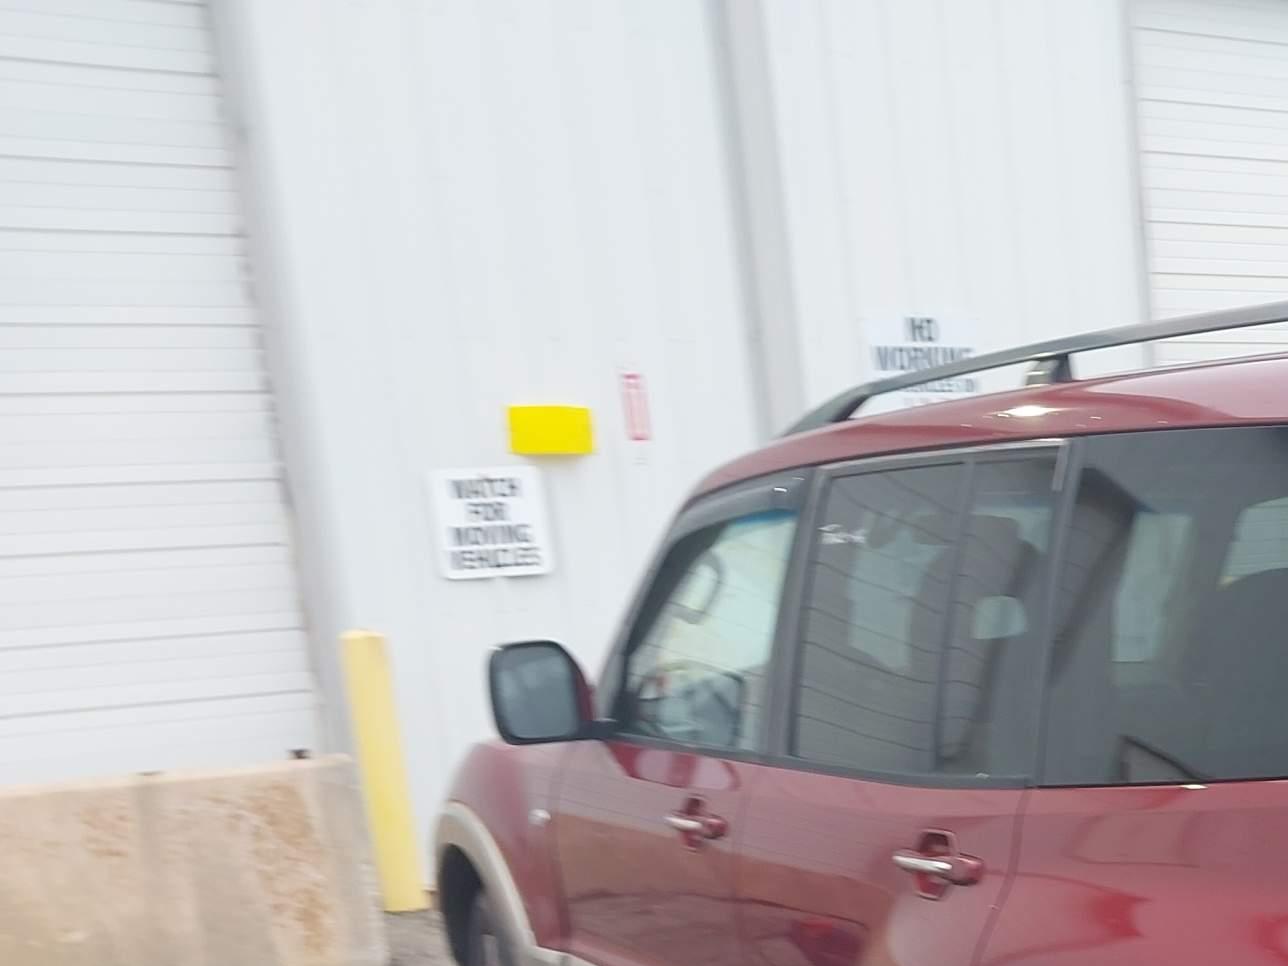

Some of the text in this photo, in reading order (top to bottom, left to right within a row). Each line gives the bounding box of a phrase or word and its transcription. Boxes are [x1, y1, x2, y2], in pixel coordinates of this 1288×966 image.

[449, 477, 521, 498] WATCH
[466, 501, 508, 521] FOR
[450, 523, 534, 546] MOVING
[450, 546, 542, 570] VEHICLES
